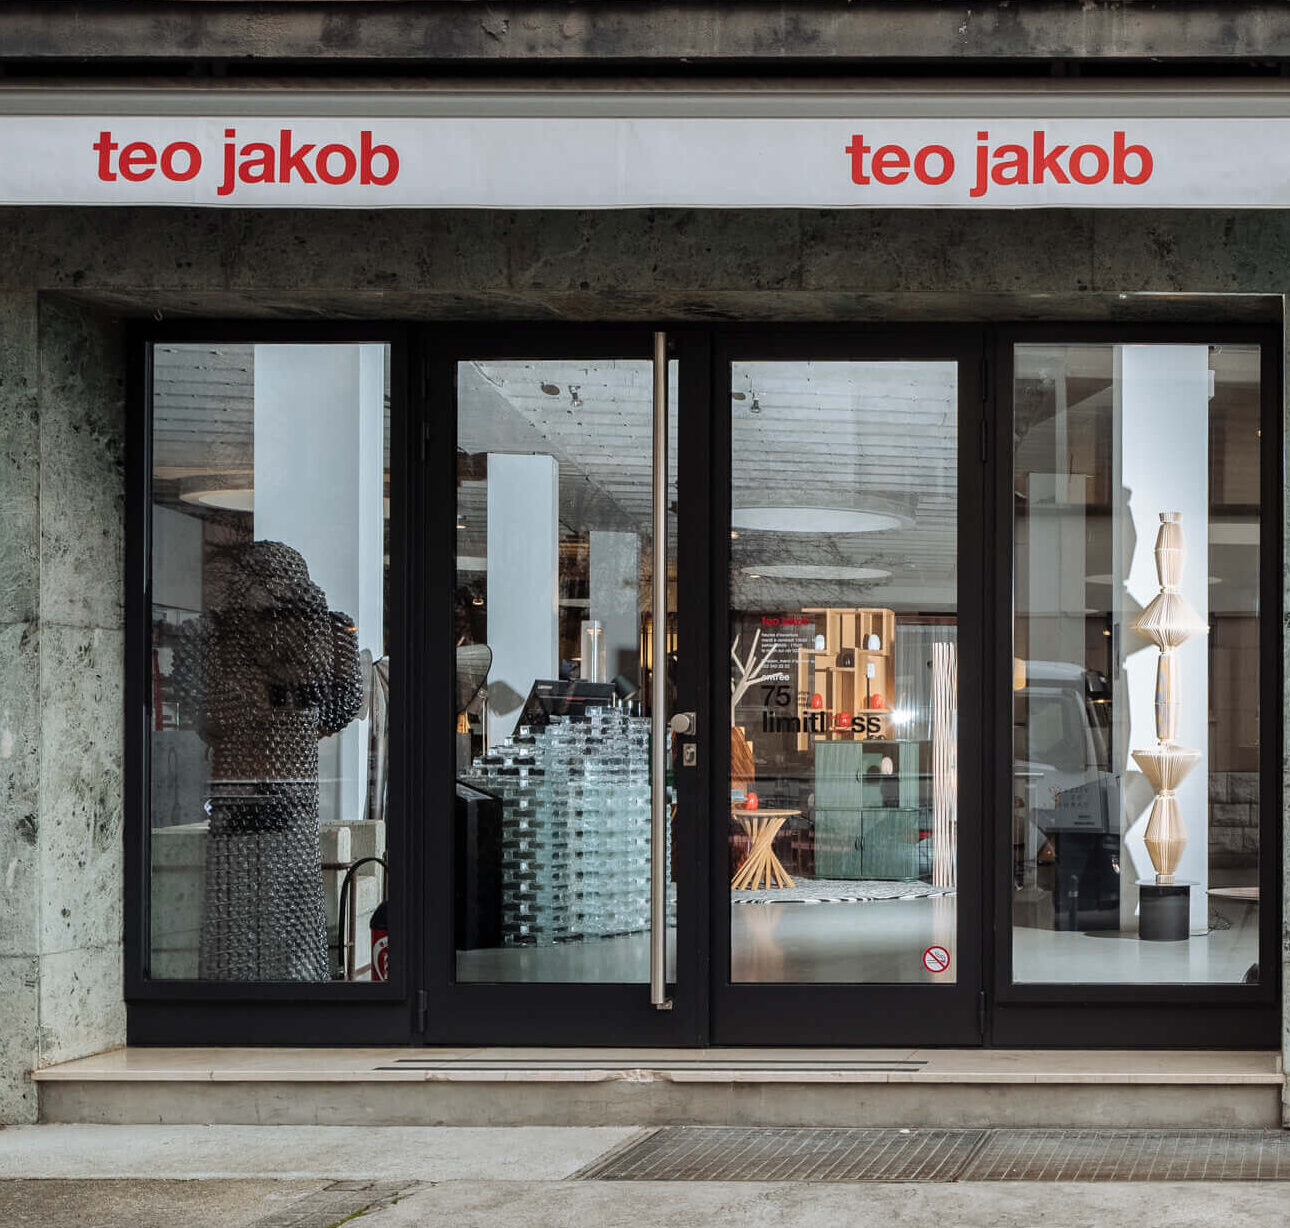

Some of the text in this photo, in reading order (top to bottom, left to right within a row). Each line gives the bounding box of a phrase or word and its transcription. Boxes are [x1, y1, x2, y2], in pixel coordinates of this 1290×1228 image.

[93, 128, 400, 196] teo jakob
[845, 131, 1154, 198] teo jakob
[761, 685, 792, 707] 75
